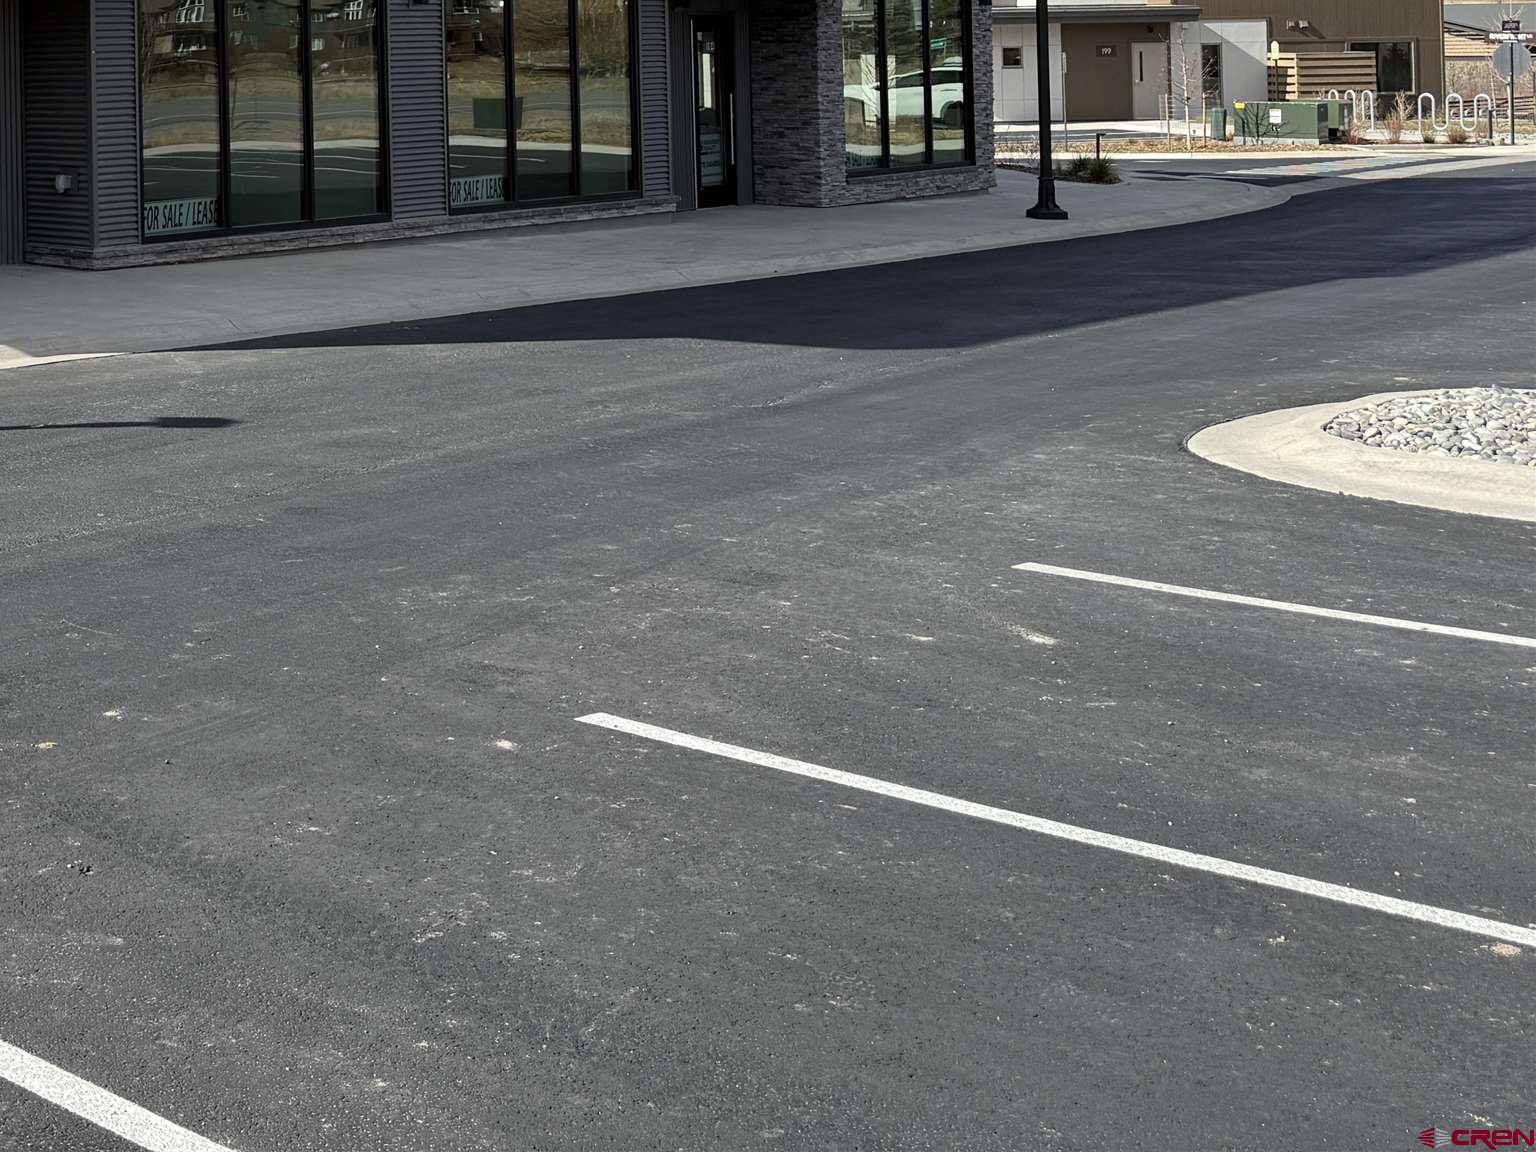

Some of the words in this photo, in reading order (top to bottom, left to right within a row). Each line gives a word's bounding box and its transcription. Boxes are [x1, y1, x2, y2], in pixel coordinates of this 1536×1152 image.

[450, 181, 461, 203] OR
[464, 179, 479, 201] SALE
[162, 203, 183, 229] SALE
